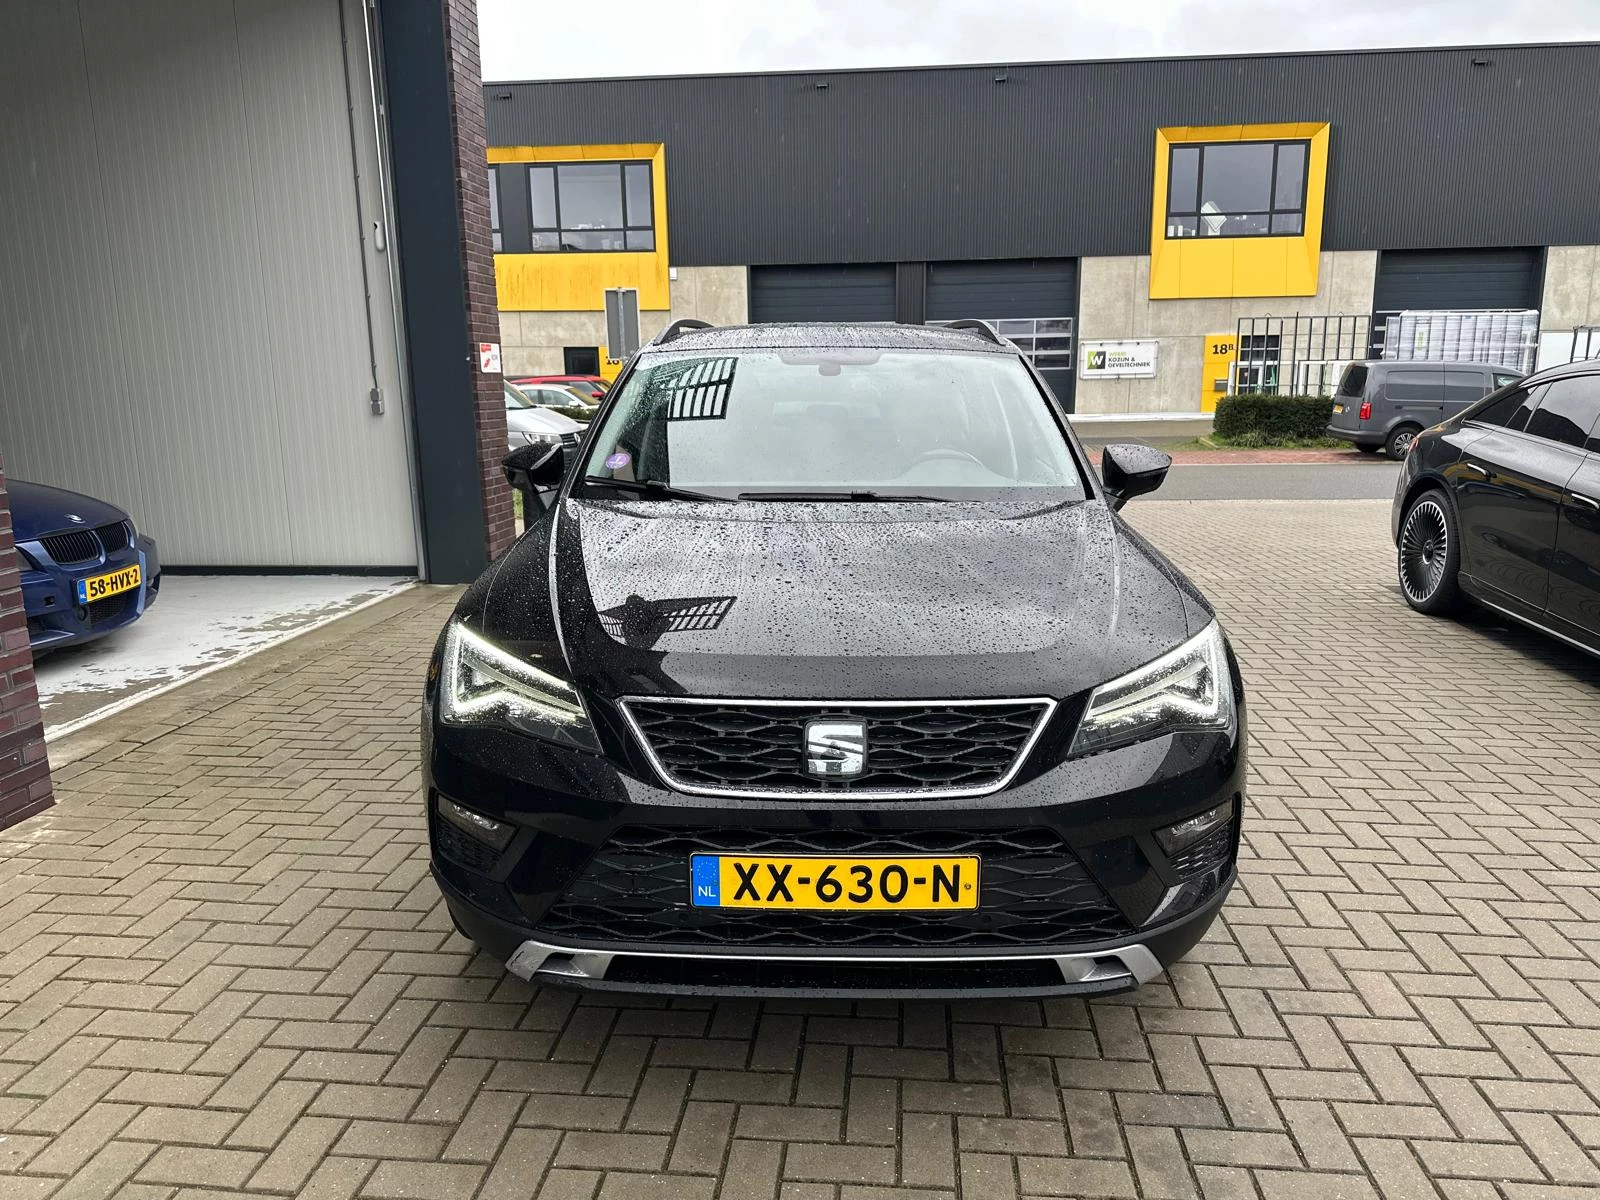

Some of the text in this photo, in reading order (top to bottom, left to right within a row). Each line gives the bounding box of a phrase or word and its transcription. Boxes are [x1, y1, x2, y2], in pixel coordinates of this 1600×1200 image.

[89, 568, 139, 598] 58-HVX-2
[698, 886, 717, 898] NL
[733, 862, 961, 904] XX-630-N
